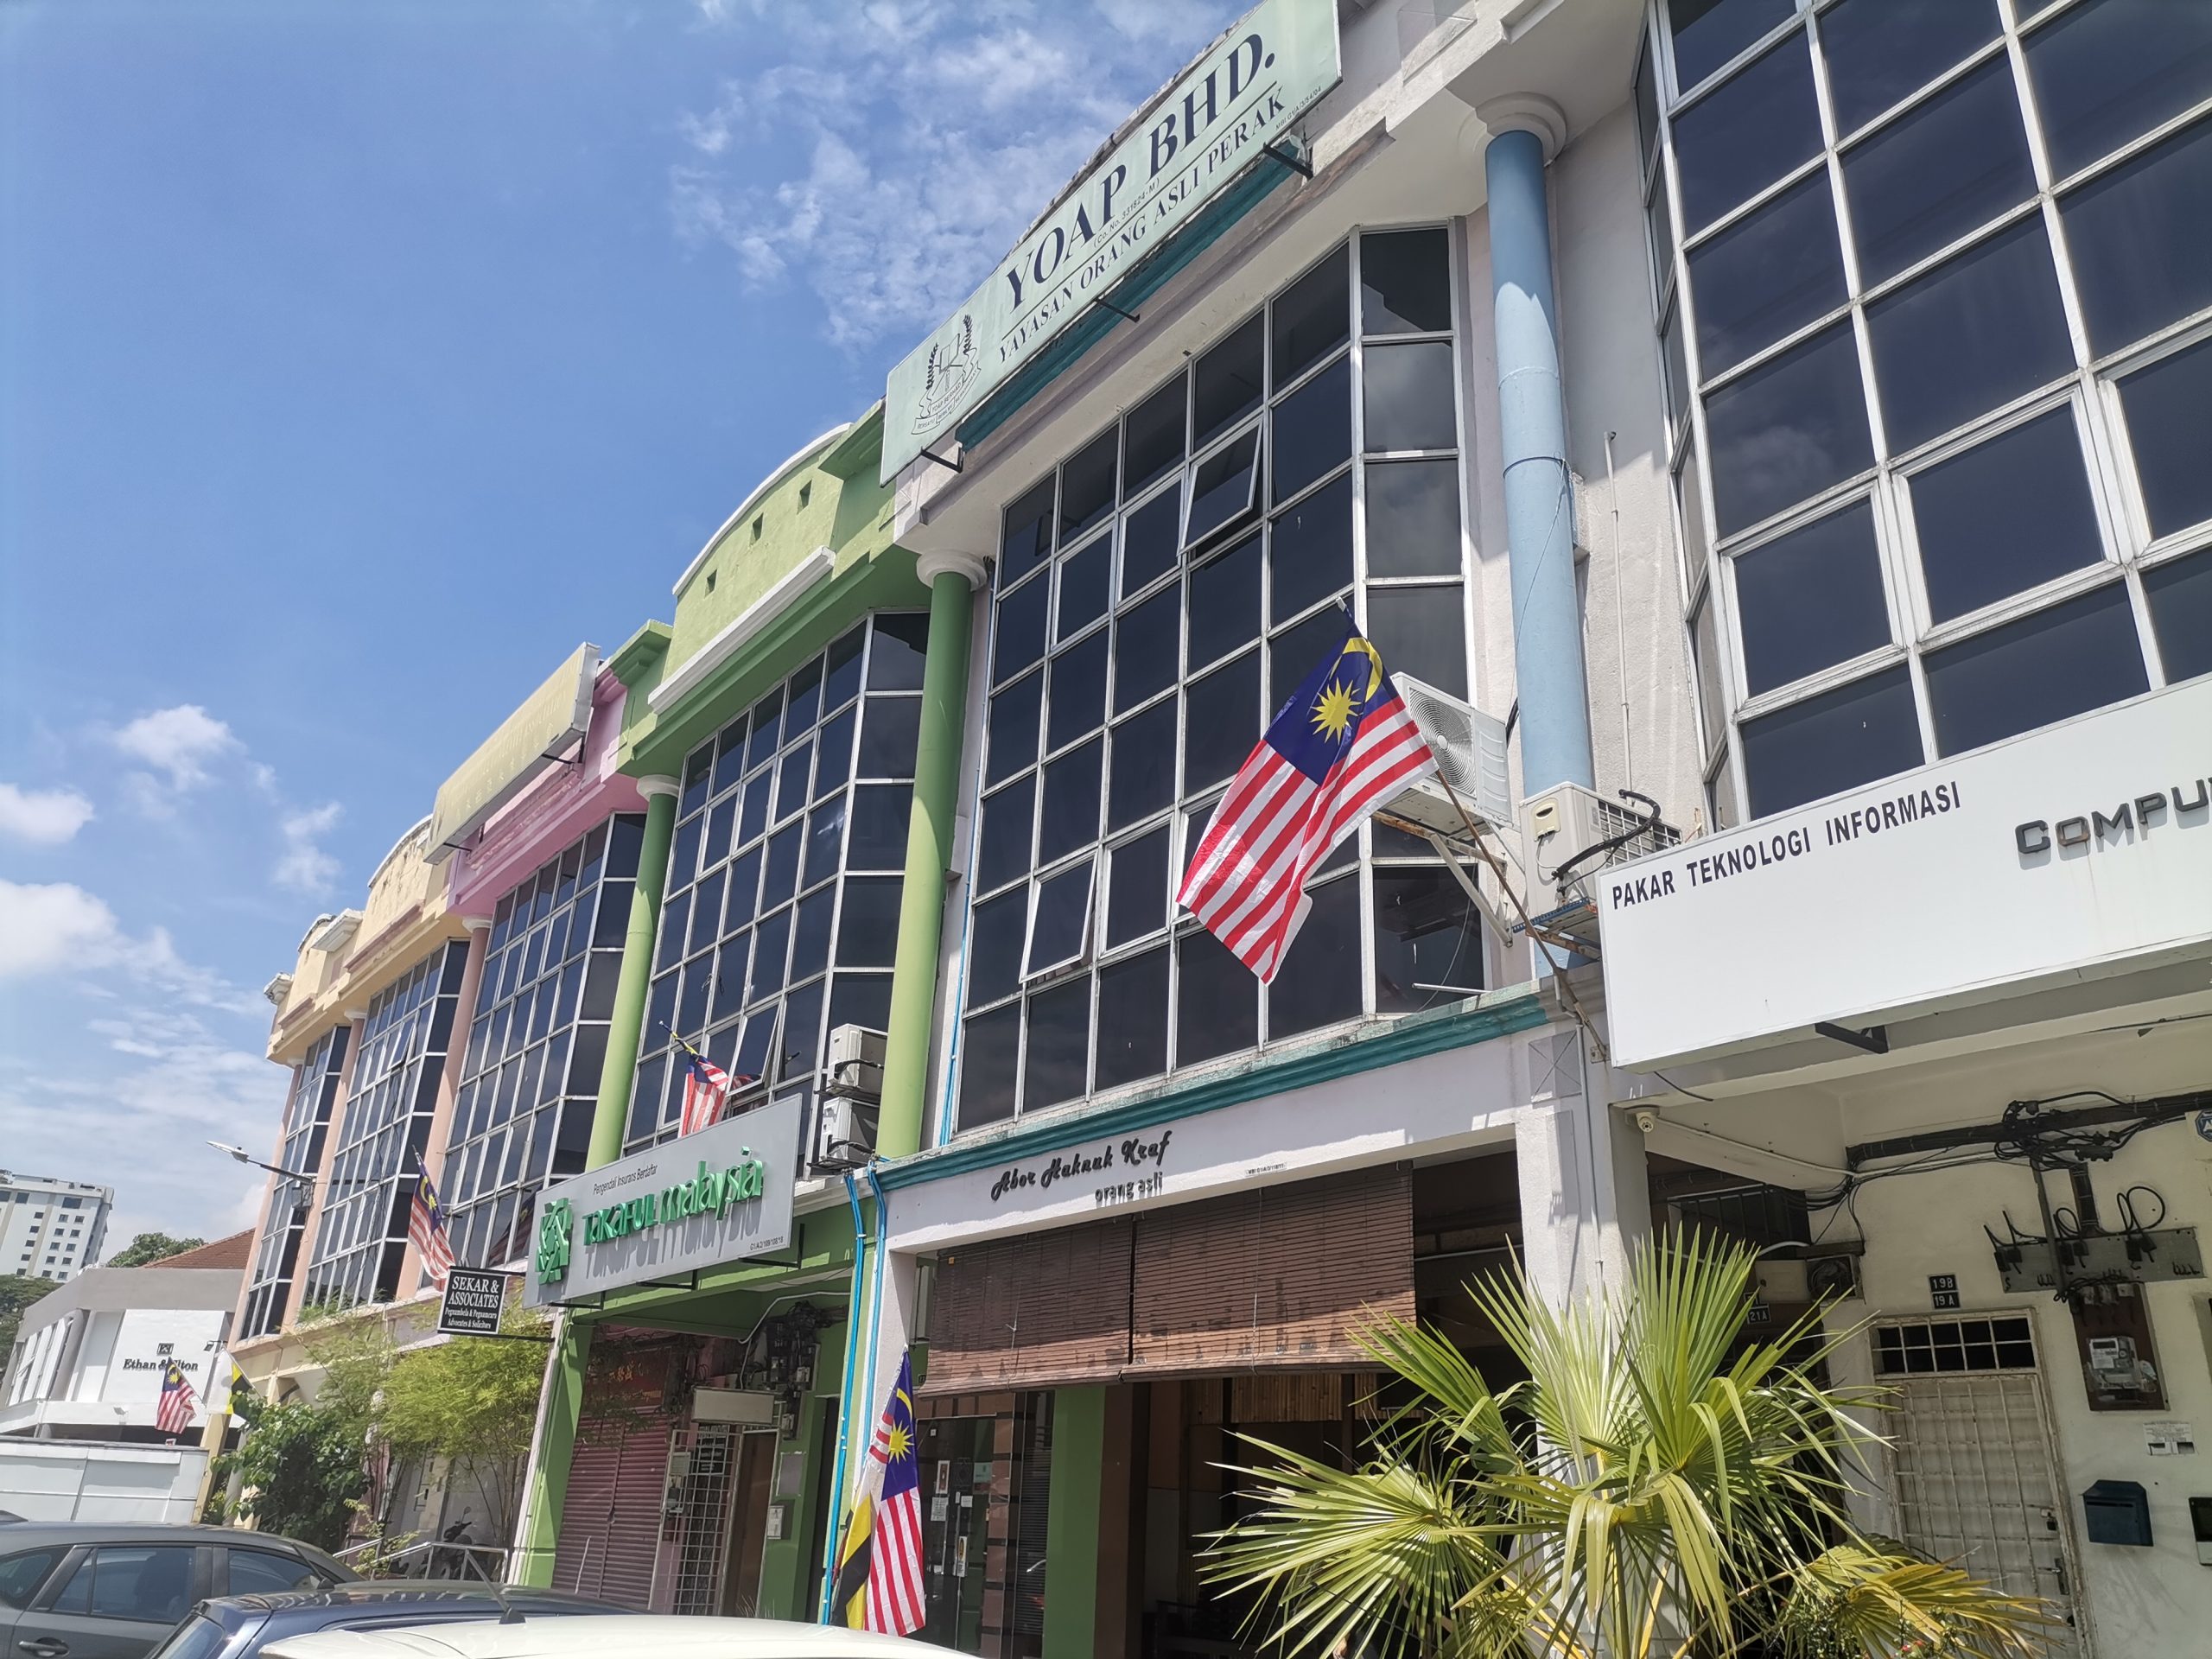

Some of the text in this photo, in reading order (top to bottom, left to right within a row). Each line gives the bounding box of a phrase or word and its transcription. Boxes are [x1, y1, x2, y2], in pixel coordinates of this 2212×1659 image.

[1006, 34, 1274, 314] YOAP BHD.
[1000, 86, 1285, 365] YAYASAN ORANG ASLI PERAK
[1109, 219, 1121, 232] No.
[2015, 777, 2212, 855] COMPU
[1612, 781, 1961, 910] PAKAR TEKNOLOGI INFORMASI
[637, 1164, 658, 1180] Berdaftar
[991, 1168, 1036, 1202] Abor
[1121, 1130, 1173, 1166] Kraf
[659, 1147, 764, 1224] malaysia
[1095, 1171, 1163, 1202] orang asli
[452, 1275, 499, 1294] SEKAR &
[448, 1291, 499, 1308] ASSOCIATES
[448, 1318, 467, 1326] Advocates
[472, 1319, 491, 1329] Solicitors
[1750, 1310, 1767, 1321] 21A
[123, 1358, 198, 1370] Ethan & lton
